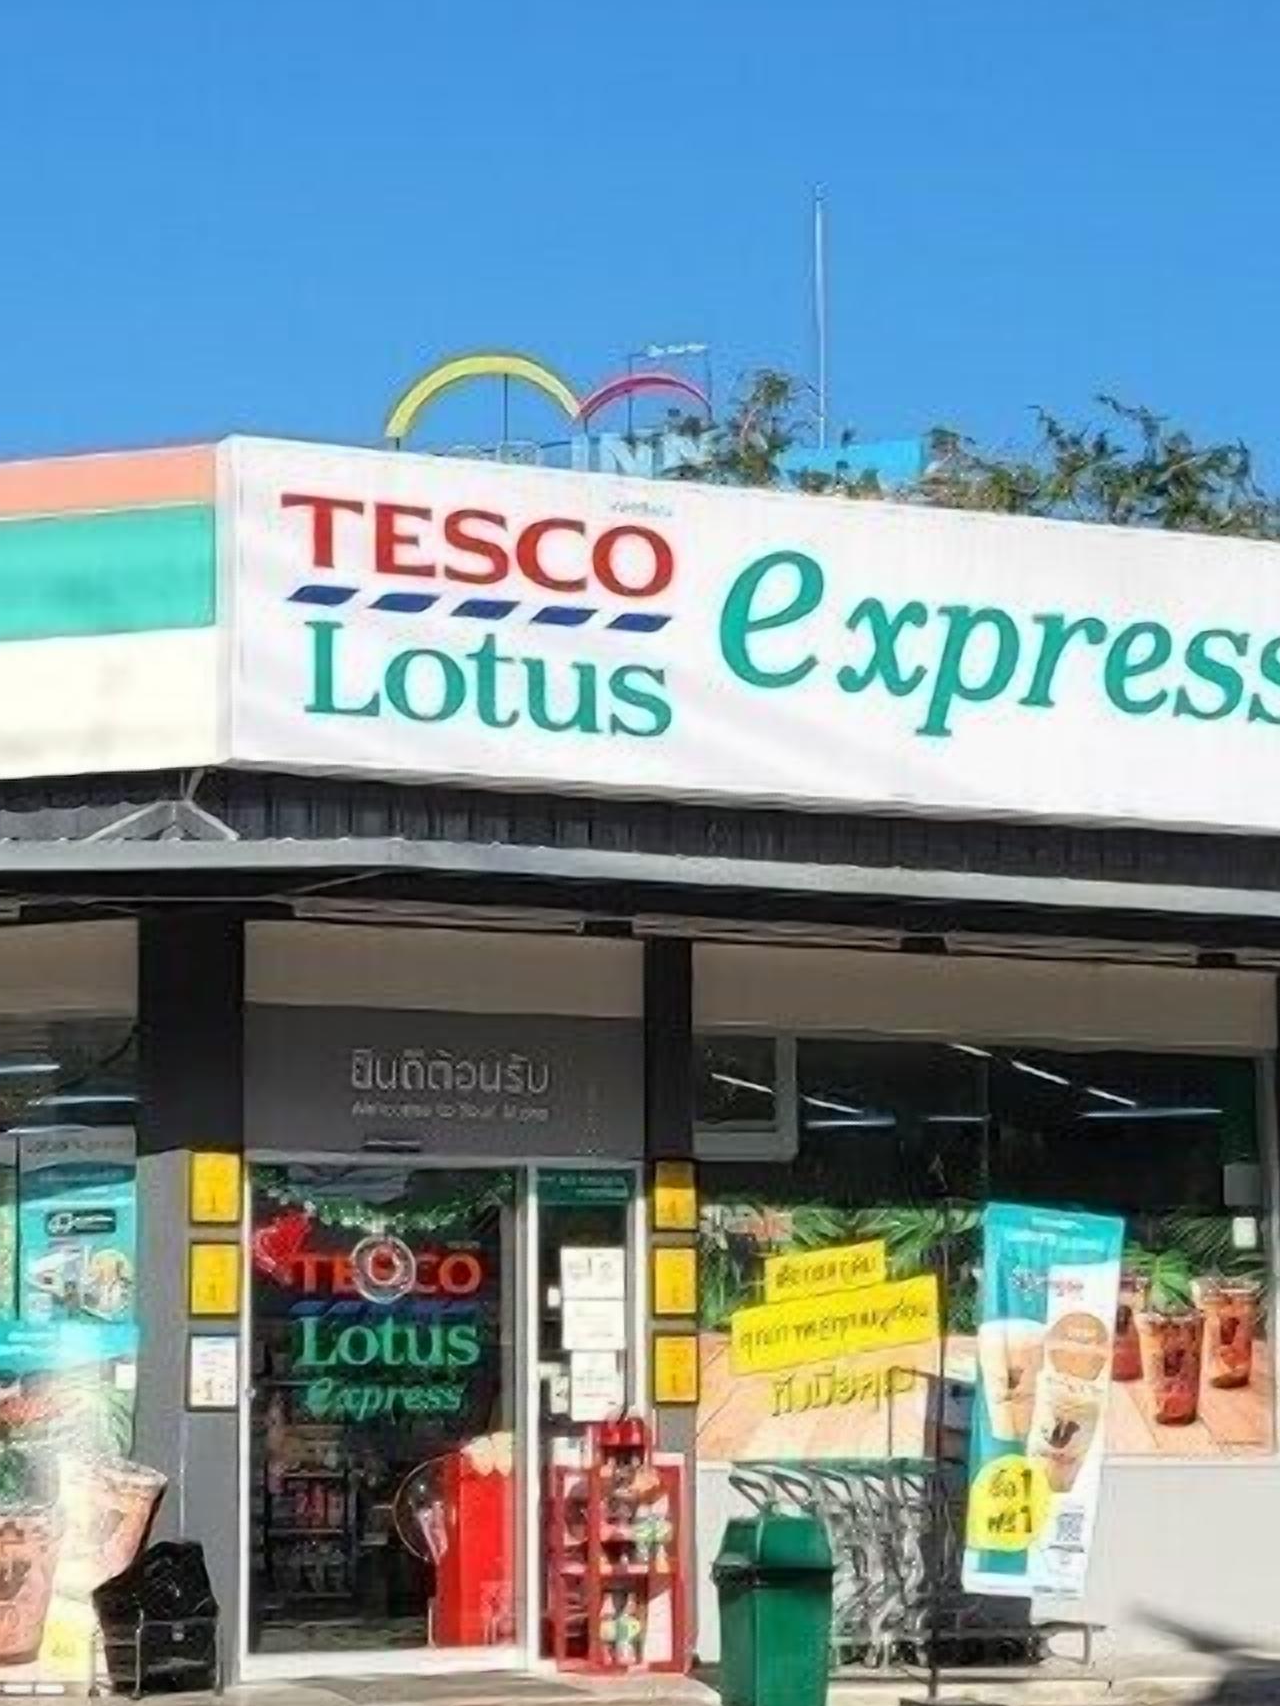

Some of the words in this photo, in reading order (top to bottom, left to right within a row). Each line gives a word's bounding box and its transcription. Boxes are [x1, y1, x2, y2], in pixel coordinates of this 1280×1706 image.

[280, 493, 675, 597] TESCO
[304, 619, 673, 737] Lotus
[351, 1047, 549, 1093] ยินดีต้อนรับ
[294, 1252, 482, 1294] TECO
[293, 1315, 482, 1367] Lotus
